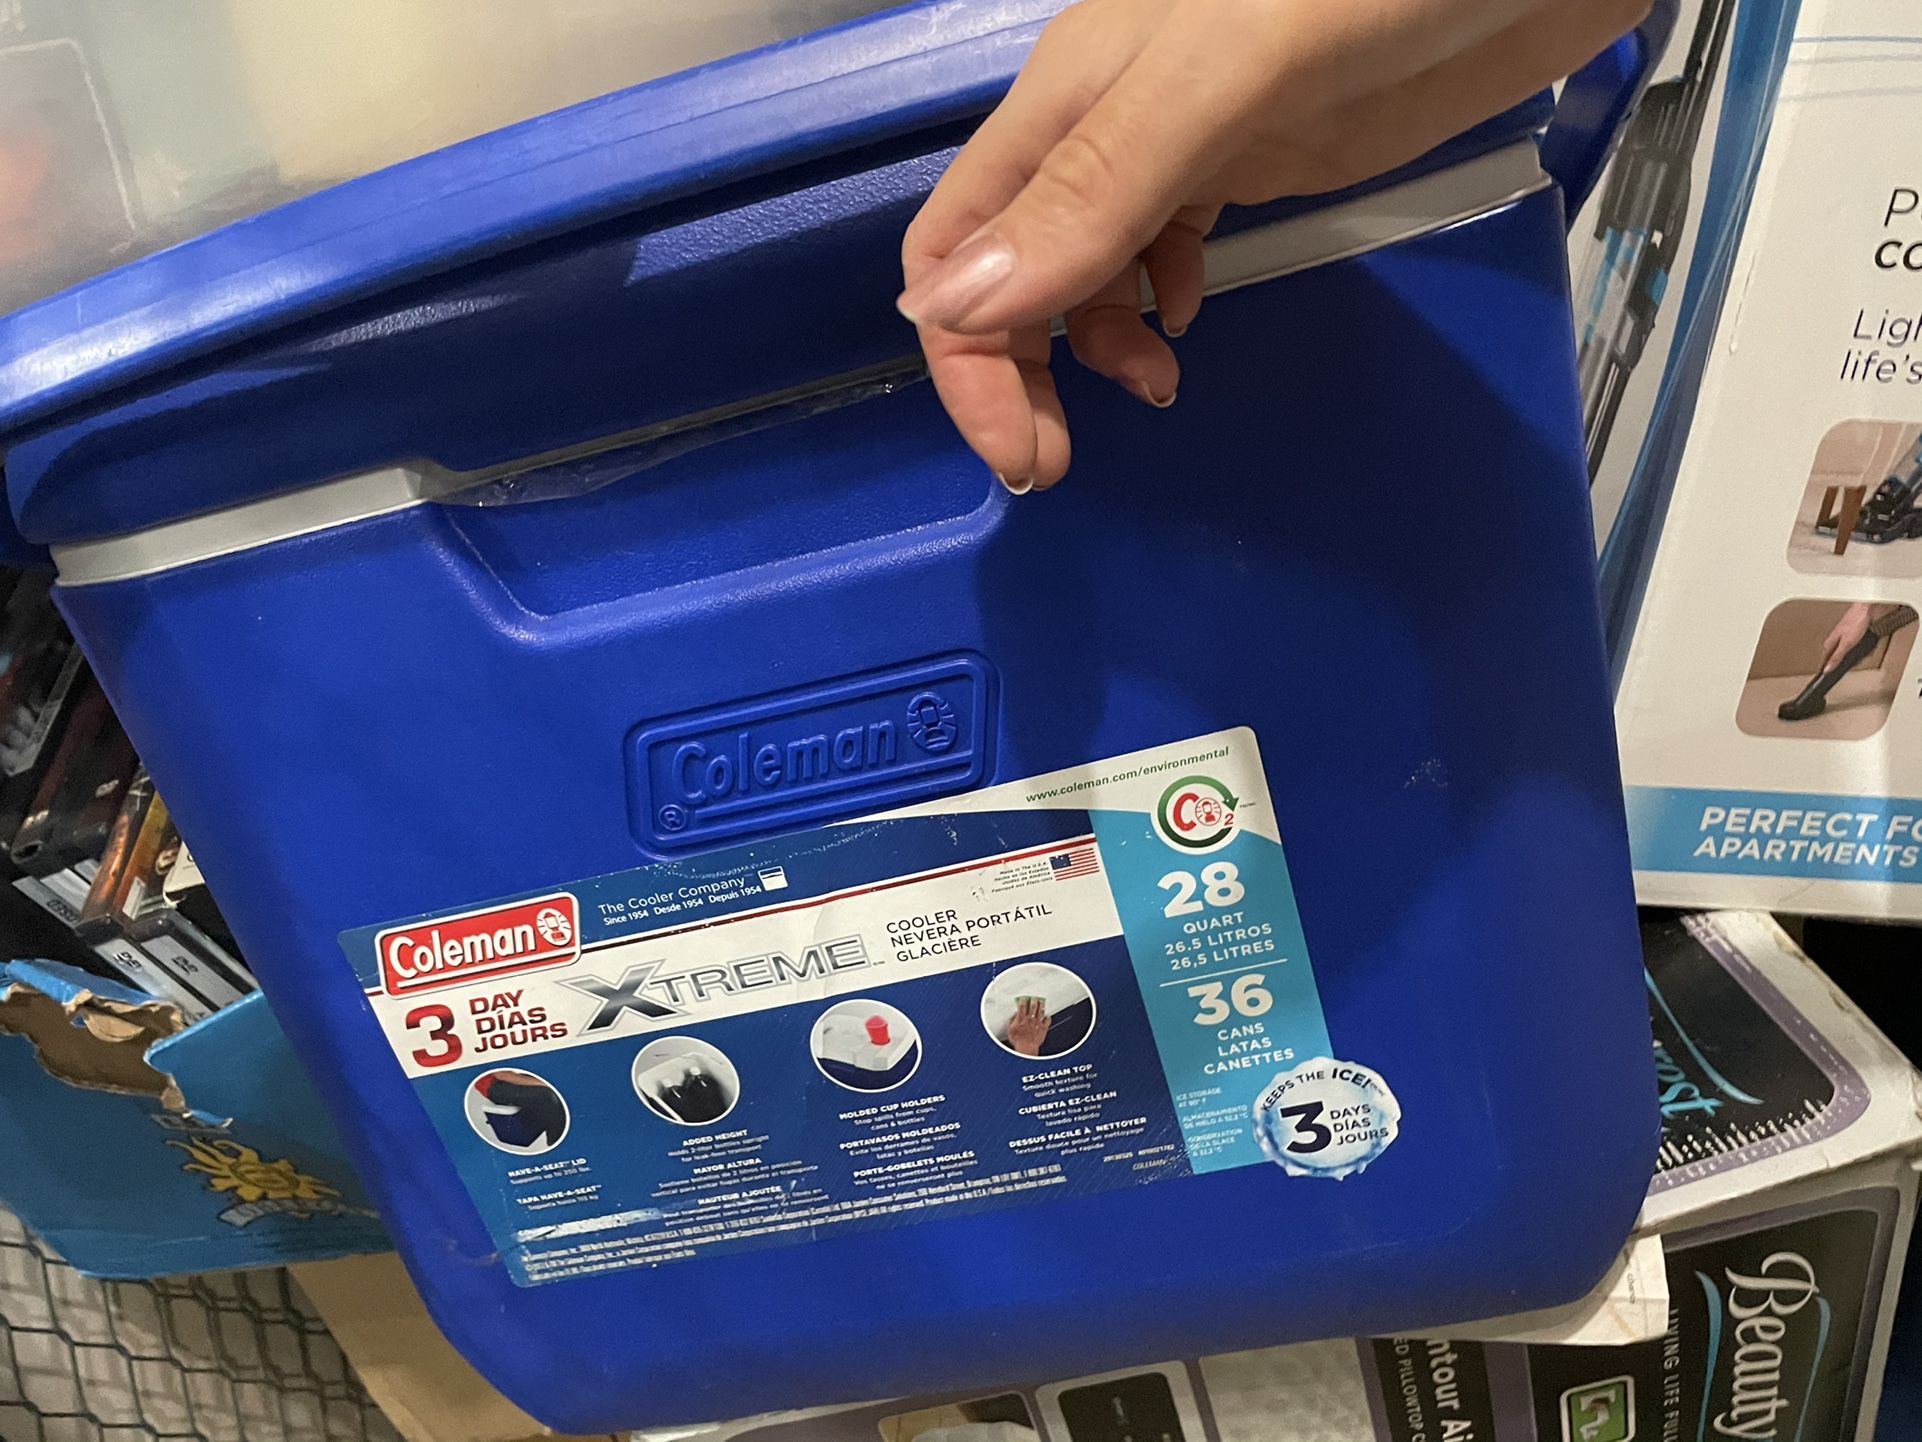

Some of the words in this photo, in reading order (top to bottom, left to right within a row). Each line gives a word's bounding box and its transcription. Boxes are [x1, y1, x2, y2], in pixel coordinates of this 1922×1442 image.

[1884, 188, 1922, 228] P
[672, 720, 897, 801] Coleman
[1026, 747, 1229, 803] www.coleman.com/environmental
[1699, 806, 1879, 840] PERFECT
[1694, 836, 1920, 868] APARTMENTS
[598, 903, 625, 915] The
[628, 892, 674, 910] Cooler
[678, 876, 745, 899] Company
[1157, 861, 1245, 918] 28
[604, 915, 627, 926] Since
[628, 910, 649, 920] 1954
[654, 904, 682, 916] Desde
[682, 898, 704, 909] 1954
[708, 891, 740, 904] Depuis
[741, 886, 762, 897] 1954
[886, 909, 958, 934] COOLER
[891, 924, 962, 948] NEVERA
[966, 904, 1053, 932] PORTÁTIL
[1184, 912, 1244, 934] QUART
[389, 925, 536, 979] Coleman
[897, 935, 982, 962] GLACIÈRE
[1165, 939, 1202, 956] 26.5
[1208, 923, 1272, 946] LITROS
[1171, 954, 1207, 970] 26,5
[1213, 940, 1275, 962] LITRES
[566, 934, 871, 1036] XTREME
[1187, 974, 1274, 1025] 36
[469, 989, 524, 1015] DAY
[406, 1004, 463, 1068] 3
[475, 1007, 547, 1035] DÍAS
[1218, 1023, 1264, 1041] CANS
[474, 1022, 568, 1053] JOURS
[1218, 1037, 1272, 1057] LATAS
[1022, 1068, 1071, 1083] EZ-CLEAN
[1072, 1064, 1093, 1072] TOP
[1204, 1048, 1295, 1075] CANETTES
[1018, 1102, 1067, 1115] CUBIERTA
[1068, 1091, 1117, 1106] EZ-CLEAN
[1261, 1080, 1295, 1112] KEEPS
[1296, 1071, 1325, 1084] THE
[839, 1108, 879, 1120] MOLDED
[880, 1103, 899, 1112] CUP
[901, 1095, 946, 1109] HOLDERS
[1330, 1104, 1371, 1120] DAYS
[683, 1136, 713, 1147] ADDED
[715, 1130, 748, 1141] HEIGHT
[840, 1133, 901, 1150] PORTAVASOS
[902, 1122, 961, 1139] MOLDEADOS
[1009, 1136, 1046, 1148] DESSUS
[1048, 1130, 1082, 1141] FACILE
[1084, 1126, 1092, 1135] À
[1095, 1117, 1147, 1132] NETTOYER
[1280, 1101, 1332, 1154] 3
[1333, 1117, 1372, 1133] DÍAS
[1337, 1128, 1388, 1146] JOURS
[571, 1158, 587, 1166] LID
[693, 1164, 725, 1175] MAYOR
[727, 1158, 762, 1169] ALTURA
[853, 1158, 935, 1178] PORTE-GOBELETS
[936, 1150, 975, 1164] MOULÉS
[517, 1196, 539, 1204] TAPA
[698, 1193, 740, 1205] HAUTEUR
[742, 1185, 782, 1198] AJOUTÉE
[1713, 1252, 1820, 1439] Beauty
[1426, 1340, 1460, 1411] ntour
[1664, 1374, 1679, 1407] LIFE
[1398, 1359, 1424, 1431] PILLOWTOP
